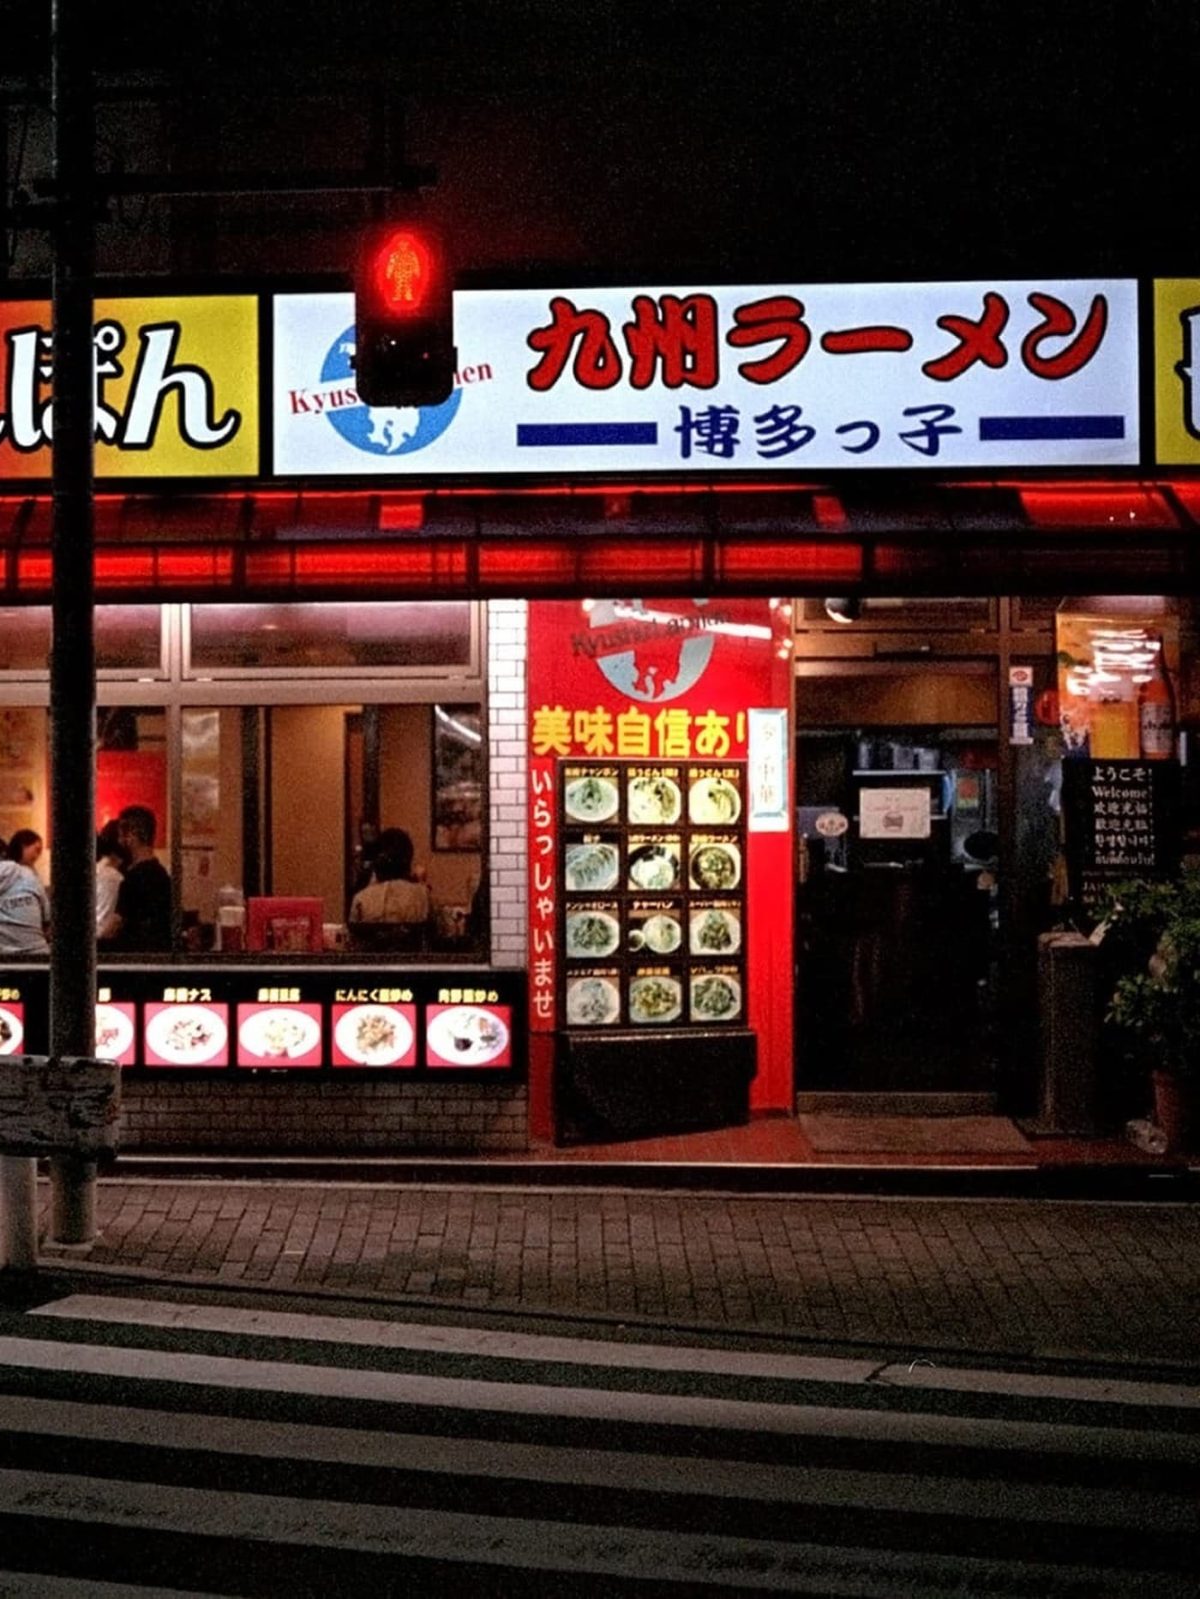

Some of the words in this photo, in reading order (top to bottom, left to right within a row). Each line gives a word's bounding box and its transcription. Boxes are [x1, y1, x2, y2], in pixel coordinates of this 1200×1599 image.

[527, 292, 1108, 391] 九州ラーメン
[288, 384, 362, 416] Kyus
[674, 403, 963, 459] 博多っ子
[531, 768, 554, 1019] いらっしゃいませ
